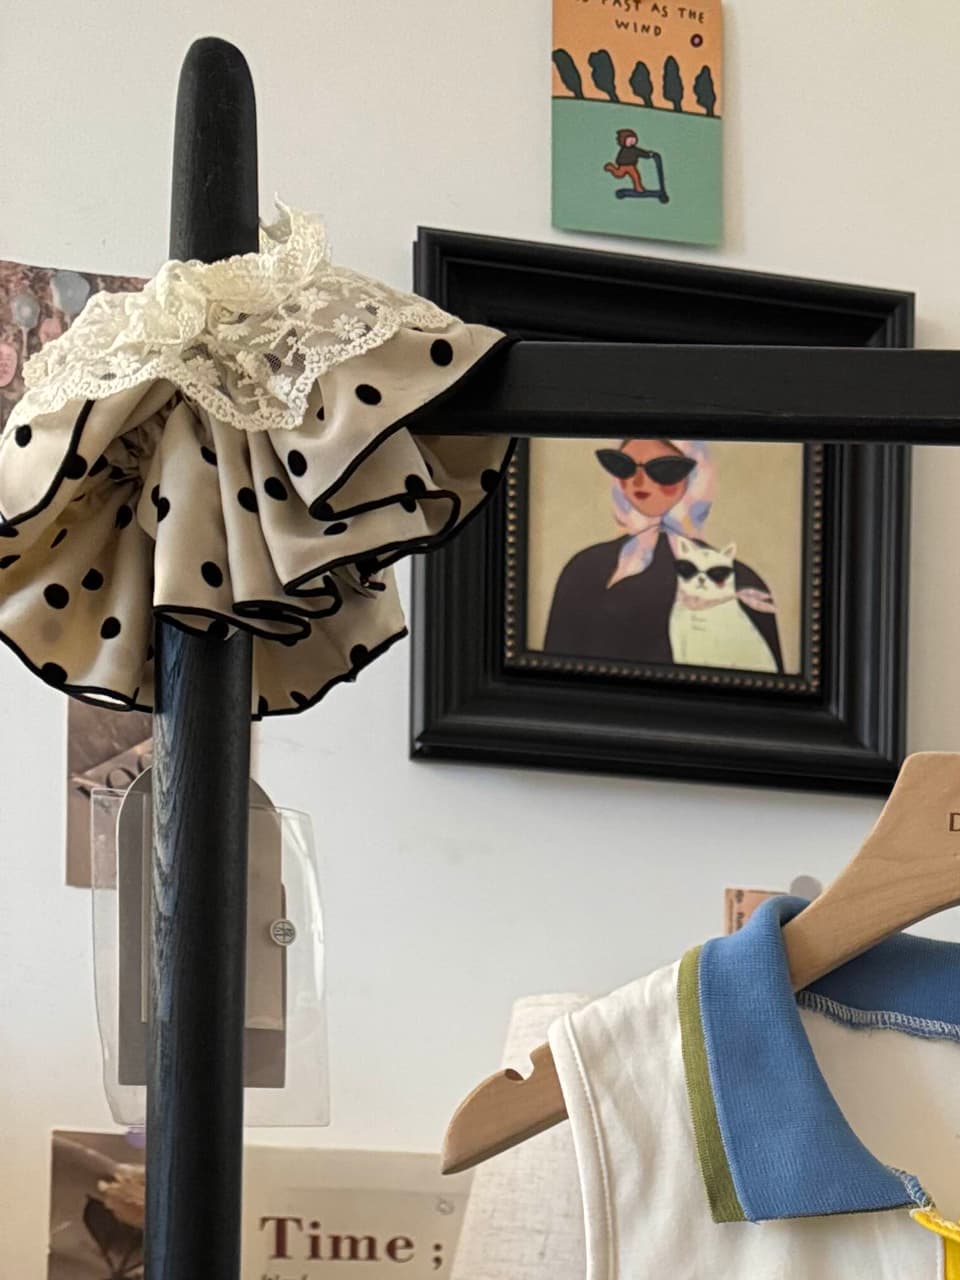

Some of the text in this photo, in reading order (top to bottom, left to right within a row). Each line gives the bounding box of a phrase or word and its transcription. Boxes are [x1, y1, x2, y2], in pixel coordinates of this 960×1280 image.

[651, 3, 668, 18] AS
[678, 7, 704, 24] THE
[615, 19, 662, 37] WIND
[259, 1216, 416, 1264] Time
